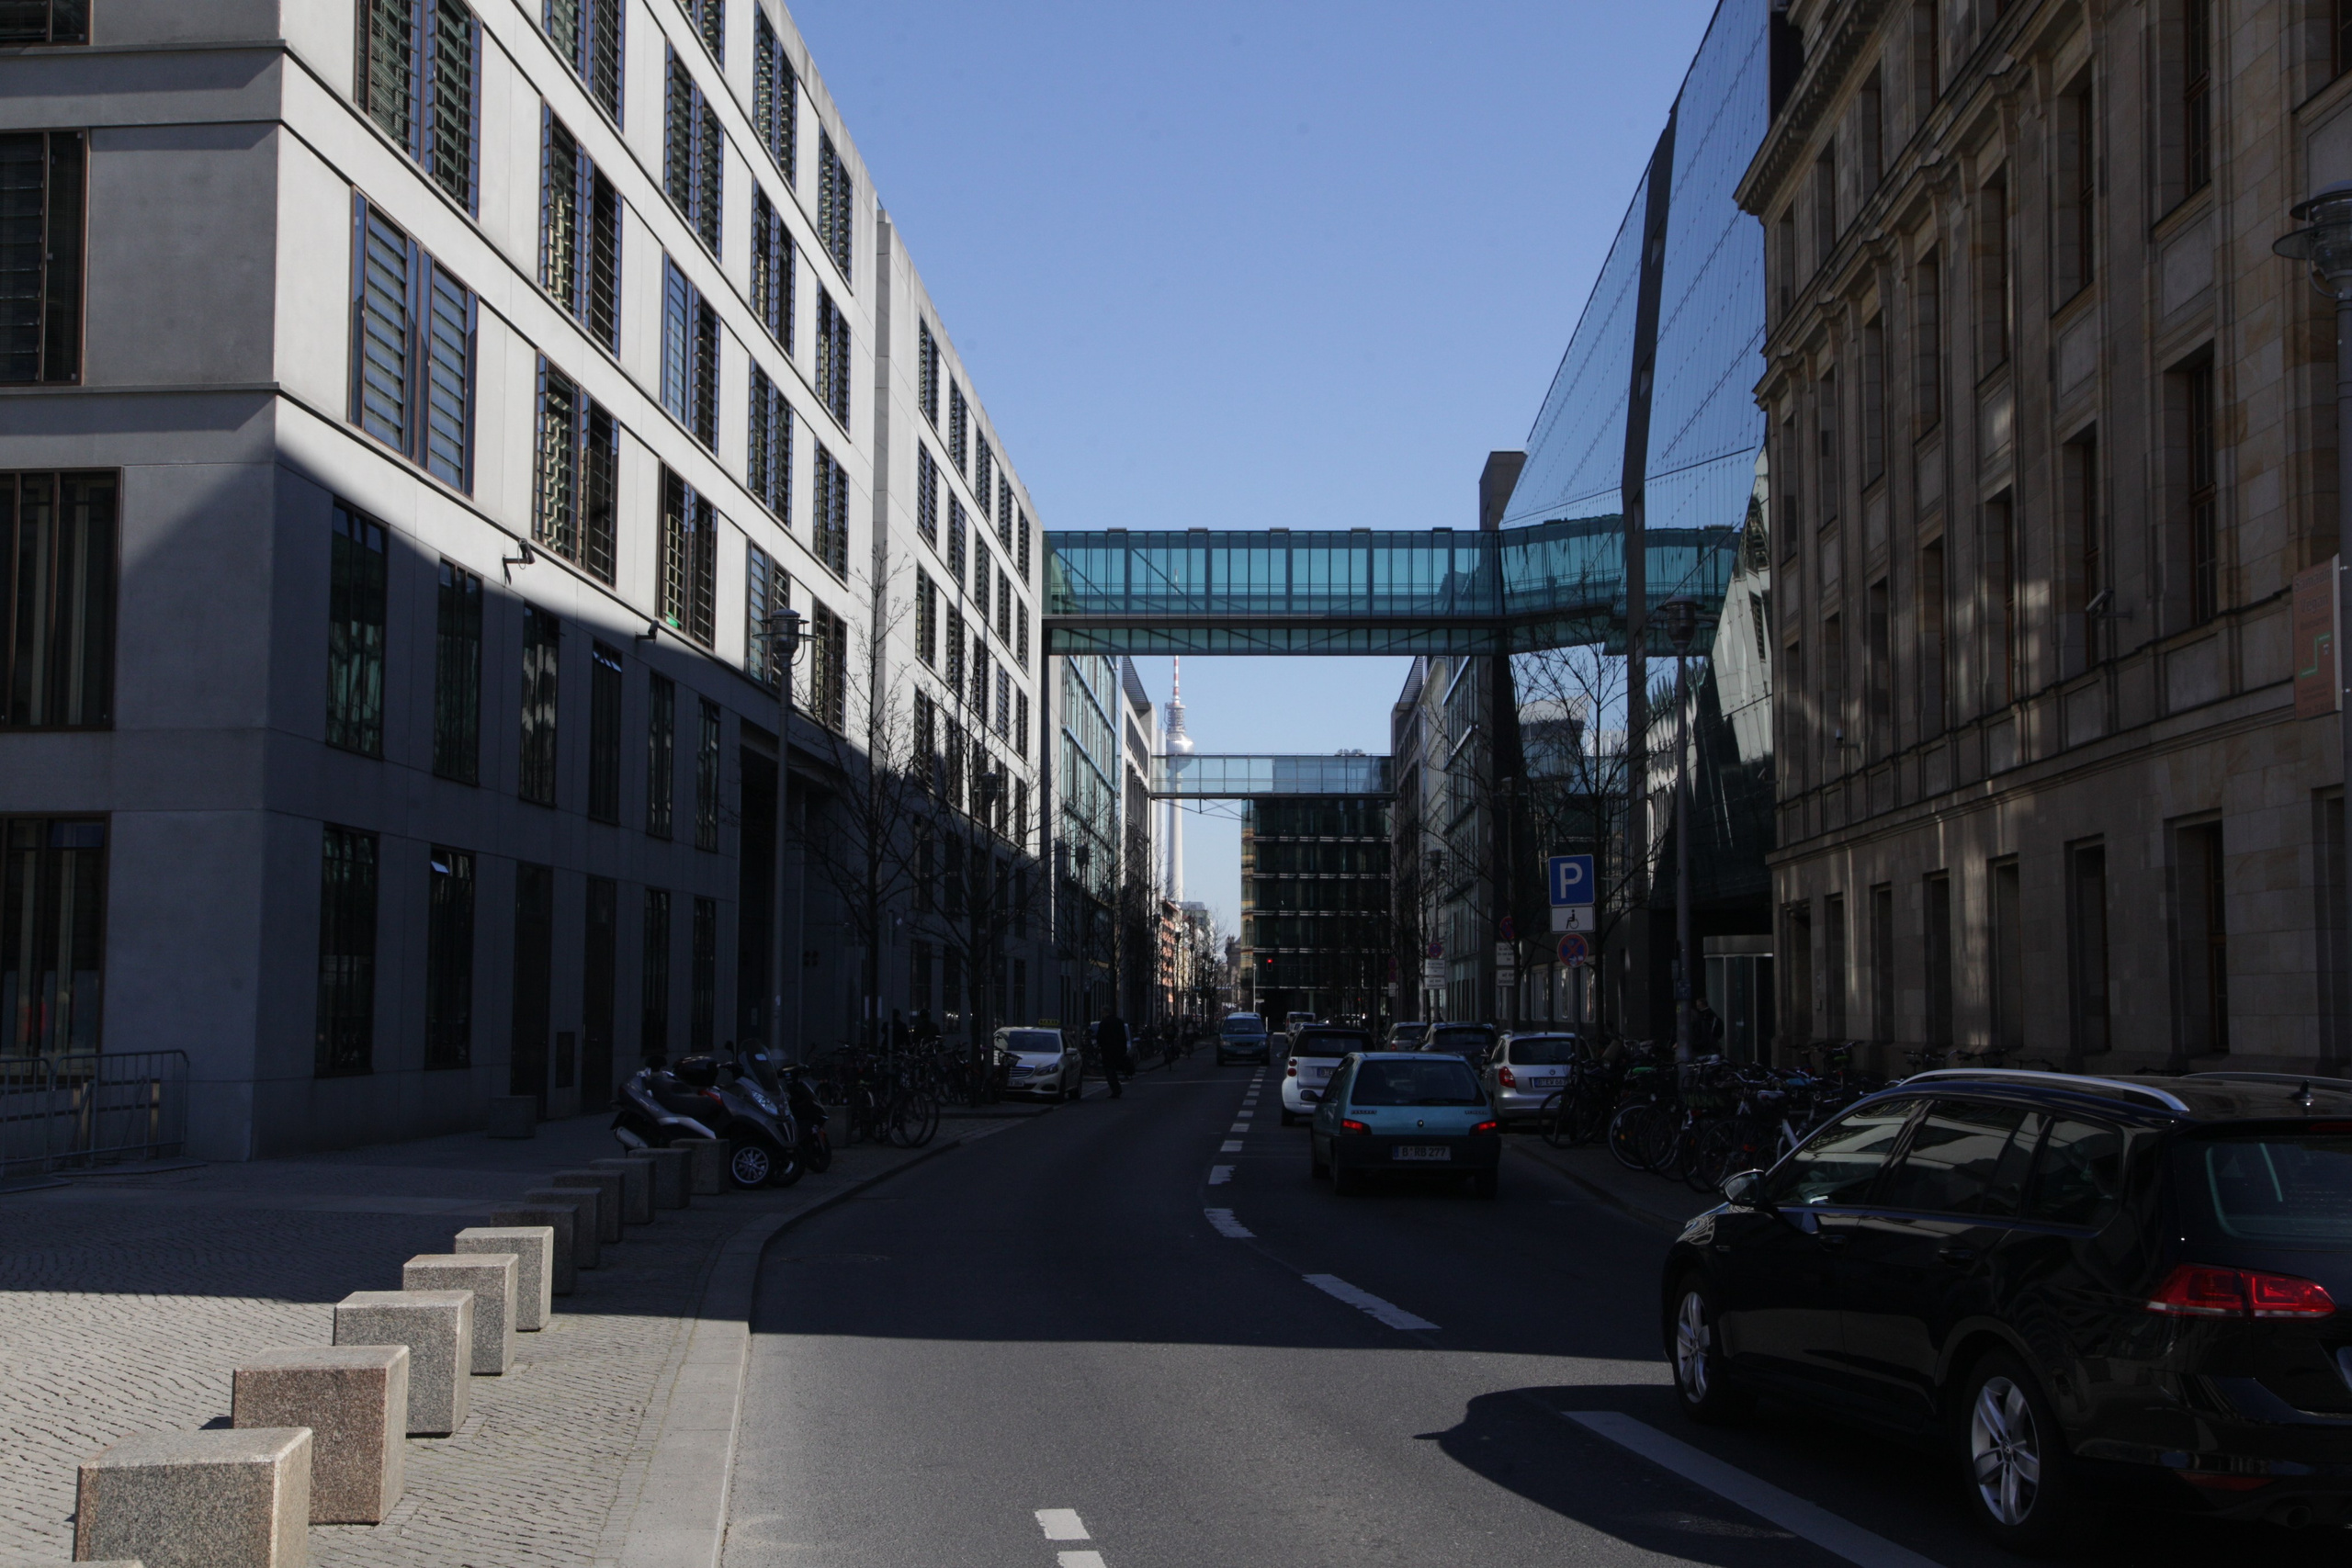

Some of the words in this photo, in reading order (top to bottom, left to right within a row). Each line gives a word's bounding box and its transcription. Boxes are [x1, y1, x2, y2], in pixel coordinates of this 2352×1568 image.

[2300, 594, 2329, 615] Vegan
[1559, 862, 1583, 899] P
[1402, 1146, 1408, 1156] B
[1414, 1147, 1427, 1157] RB
[1429, 1147, 1446, 1157] 277
